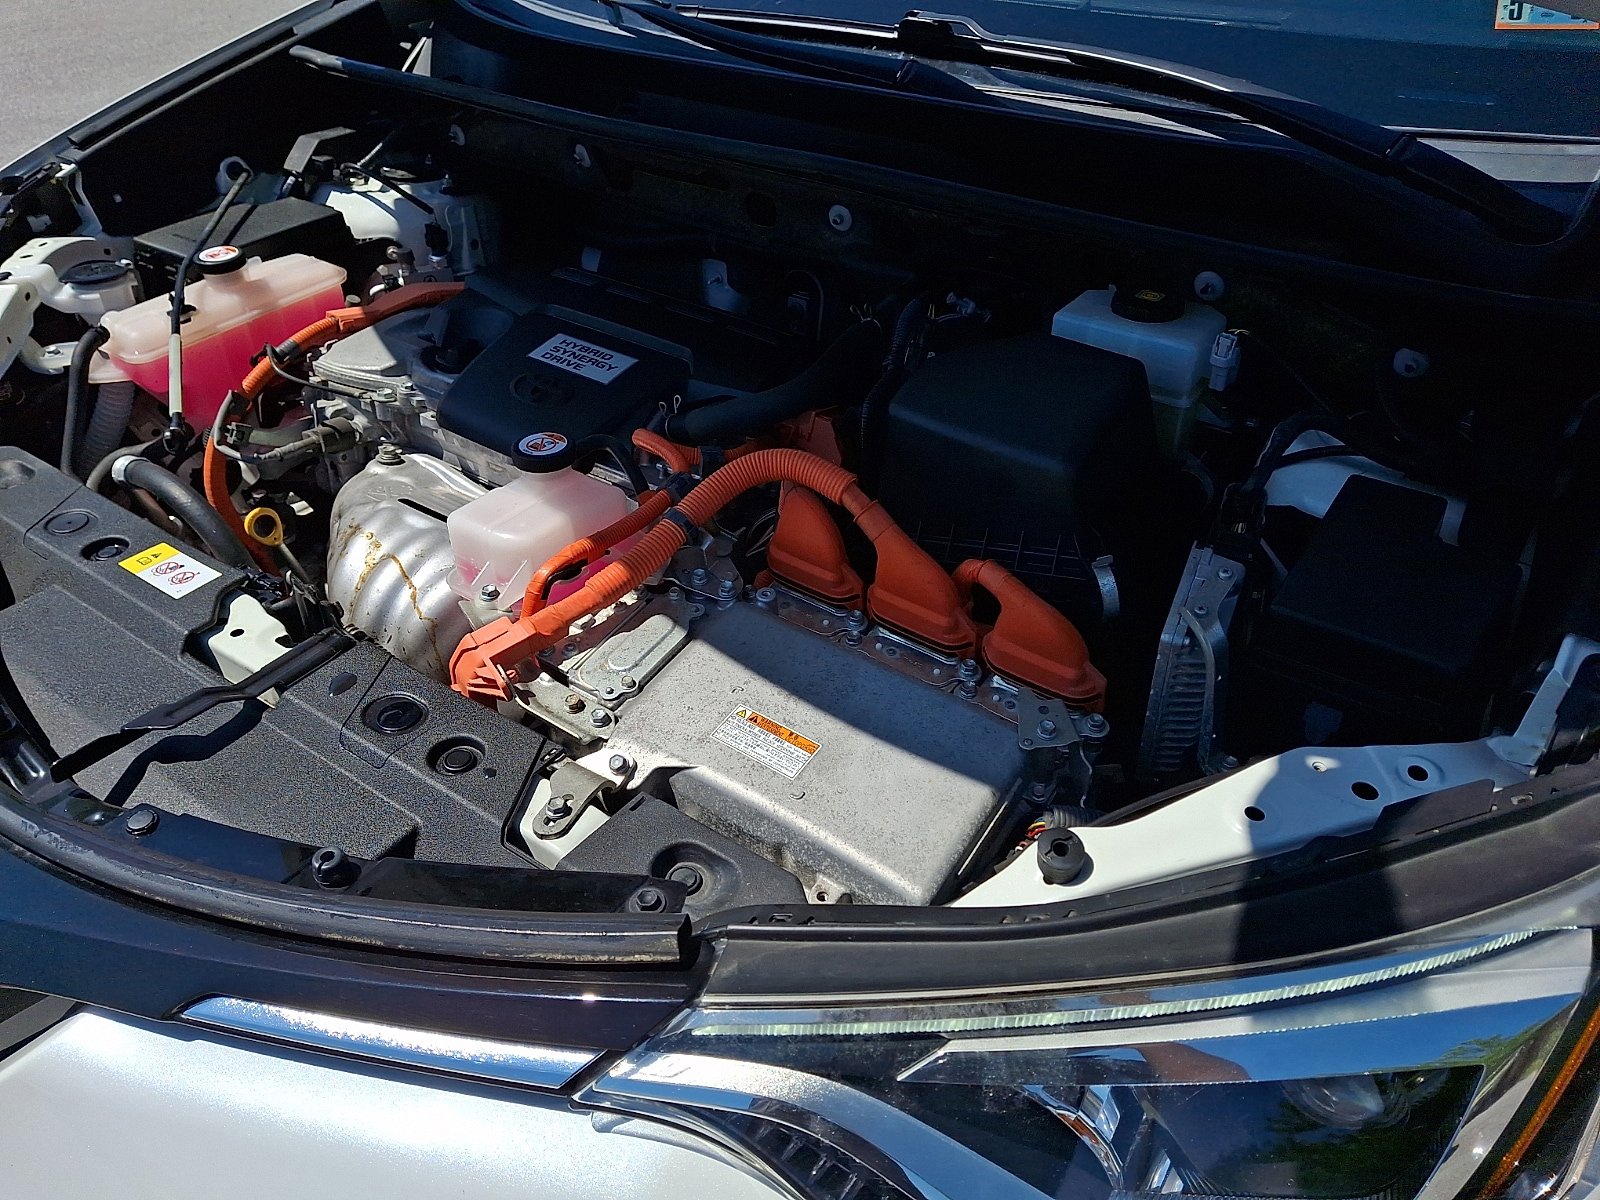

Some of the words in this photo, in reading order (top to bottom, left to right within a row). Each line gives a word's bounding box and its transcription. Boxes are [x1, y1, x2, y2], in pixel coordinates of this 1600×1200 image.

[540, 351, 586, 371] DRIVE
[550, 345, 618, 371] SYNERGY
[559, 339, 614, 361] HYBRID
